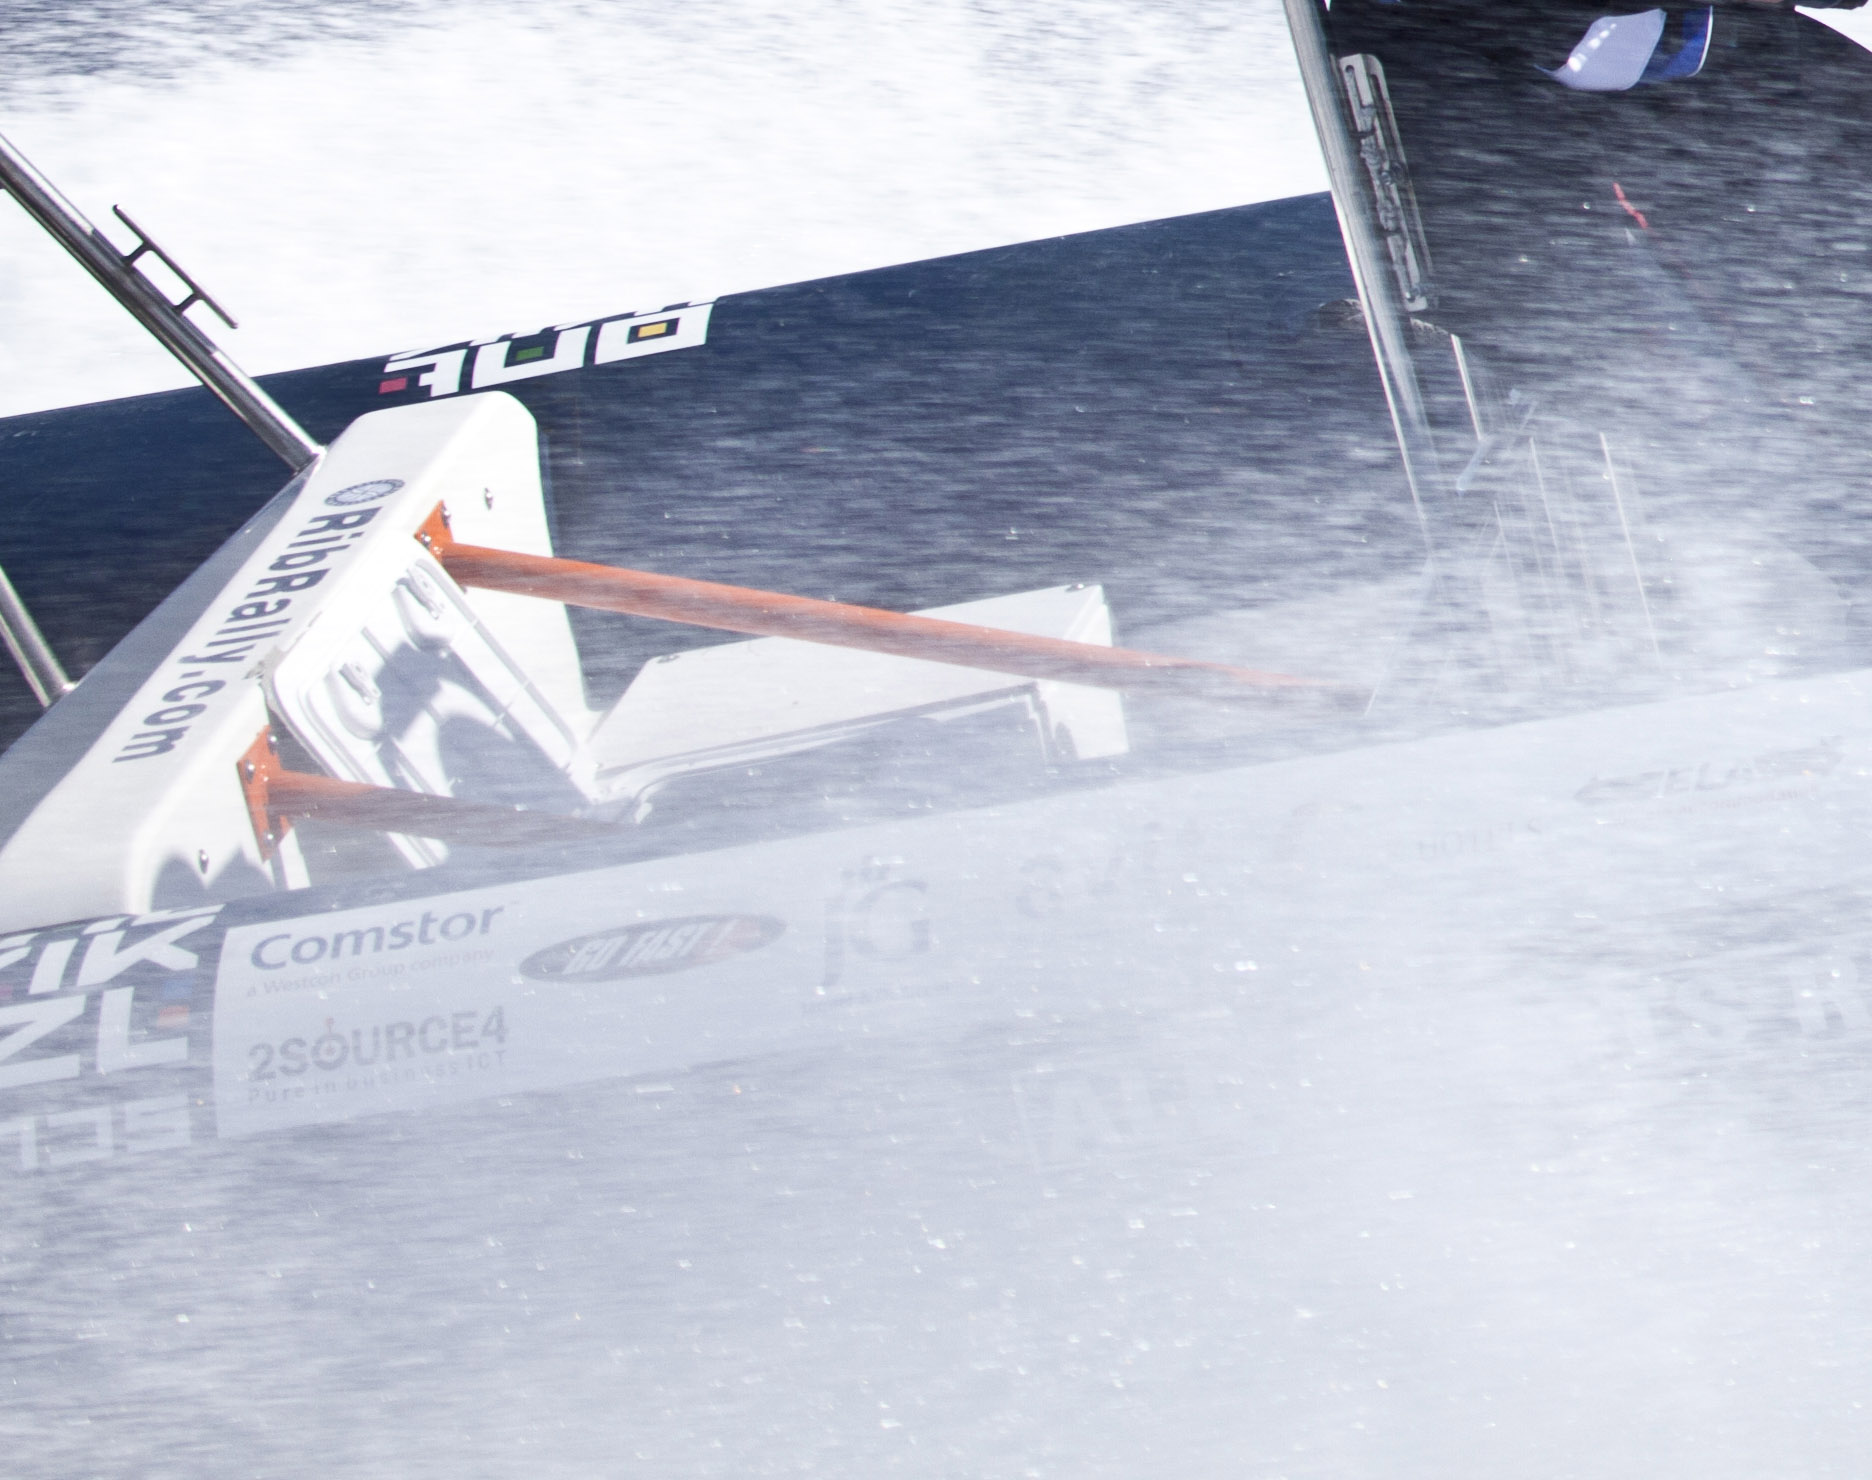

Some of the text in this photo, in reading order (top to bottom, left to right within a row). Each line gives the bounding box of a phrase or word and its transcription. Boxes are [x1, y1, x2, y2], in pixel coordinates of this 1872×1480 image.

[112, 506, 384, 764] RibRally.com
[250, 904, 505, 971] Comstor
[248, 1004, 509, 1082] 2SOURCE4
